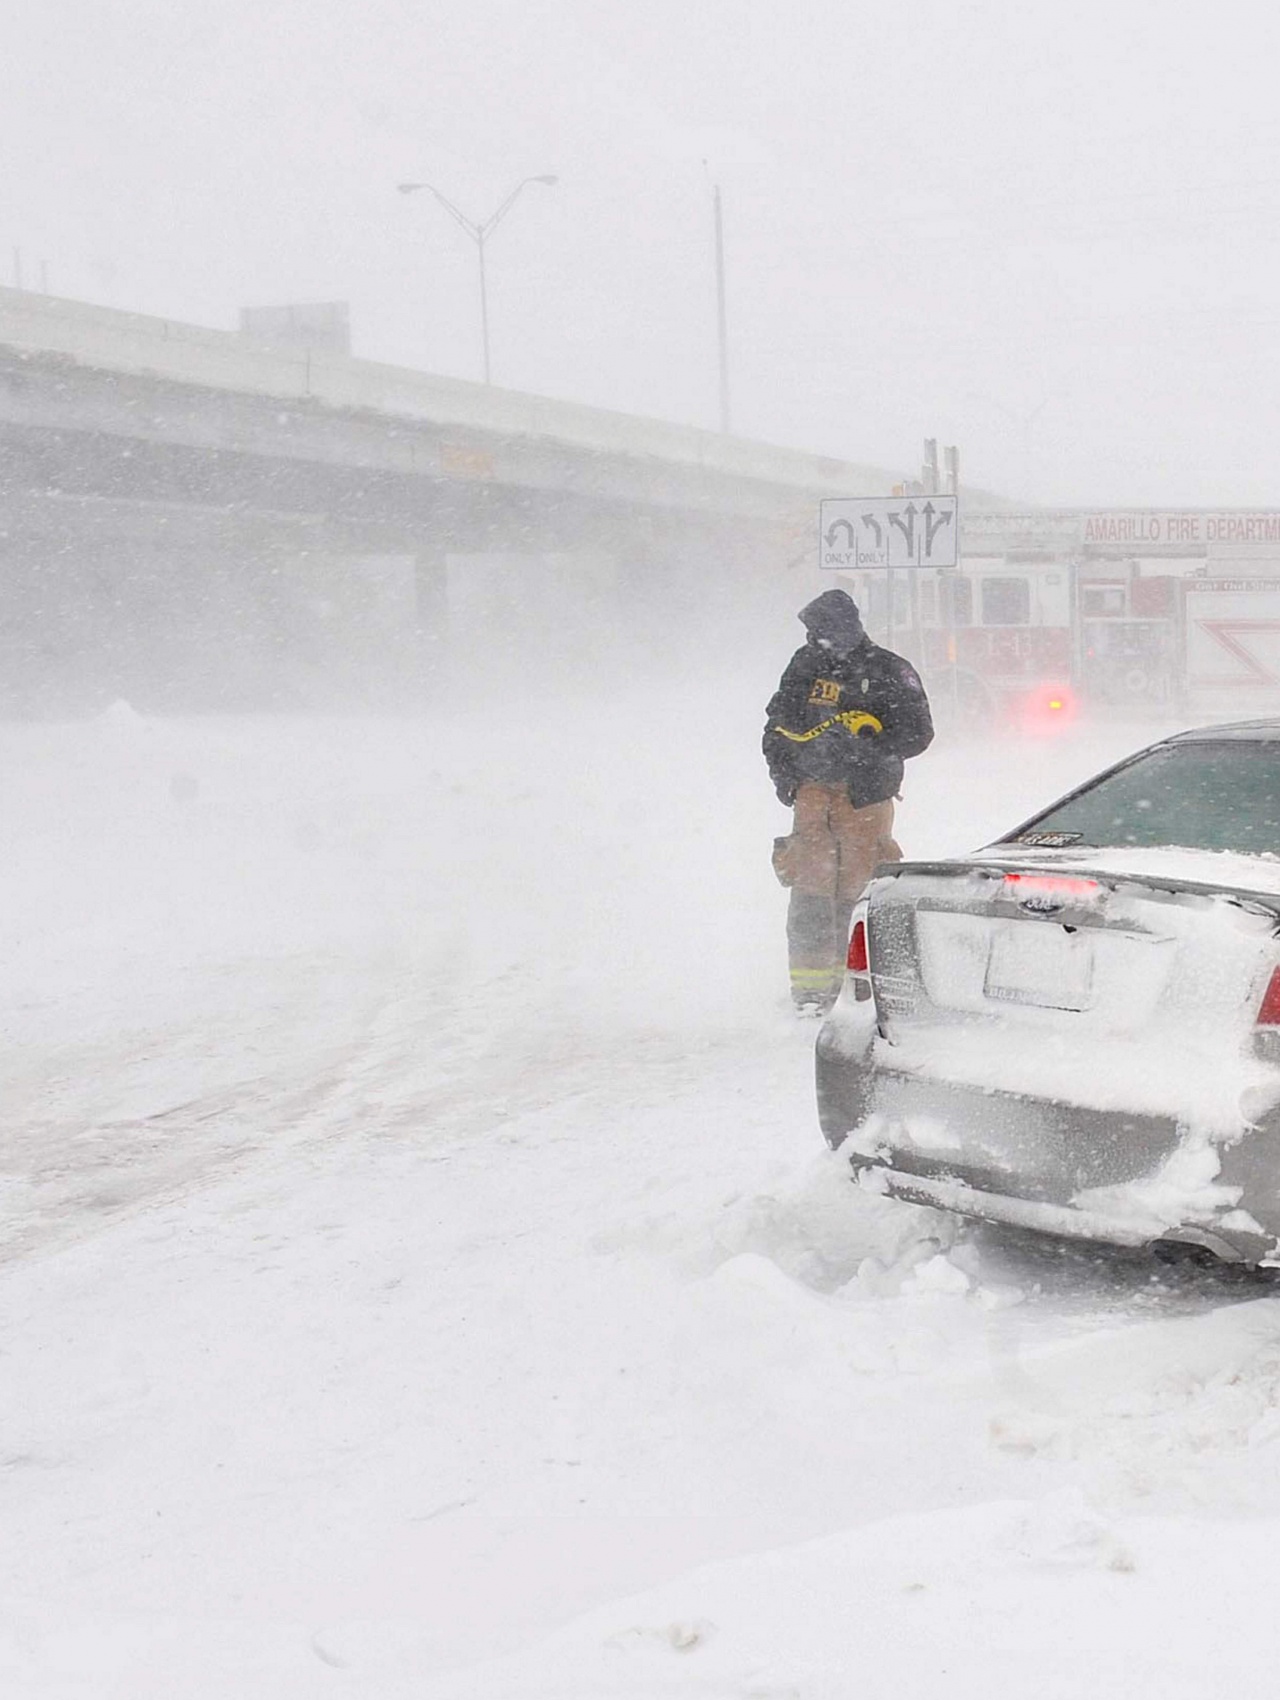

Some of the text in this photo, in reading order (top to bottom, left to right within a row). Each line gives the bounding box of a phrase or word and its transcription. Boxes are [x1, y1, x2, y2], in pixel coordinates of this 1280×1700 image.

[1085, 517, 1161, 541] AMARILLO
[1167, 517, 1199, 540] FIRE
[824, 552, 852, 564] ONLY
[859, 552, 885, 564] ONLY
